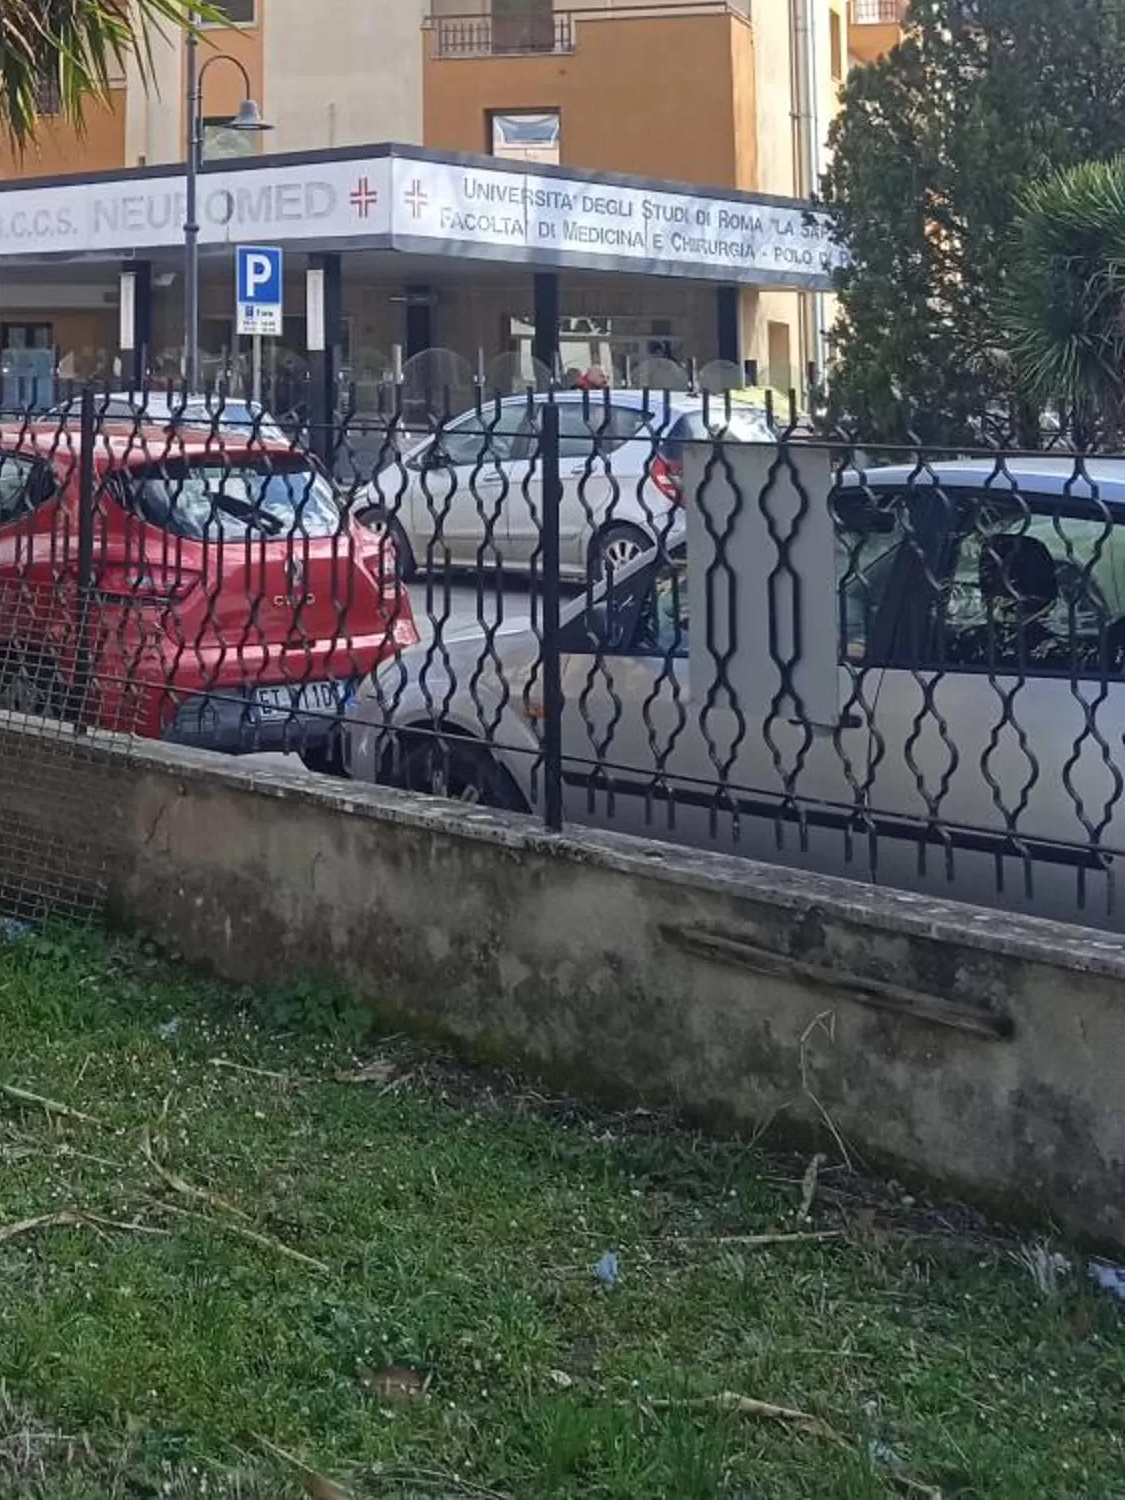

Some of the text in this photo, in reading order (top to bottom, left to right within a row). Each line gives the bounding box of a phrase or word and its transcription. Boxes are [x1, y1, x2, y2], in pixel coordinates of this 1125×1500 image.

[93, 181, 339, 232] NEUROMED
[582, 195, 632, 217] DEGLI
[642, 198, 690, 224] STUDI
[696, 209, 712, 227] DI
[718, 209, 763, 233] ROMA
[538, 221, 556, 238] DI
[562, 219, 644, 247] MEDICINA
[653, 233, 663, 249] E
[671, 231, 755, 260] CHIRURGIA
[775, 246, 812, 264] POLO
[246, 253, 272, 297] P
